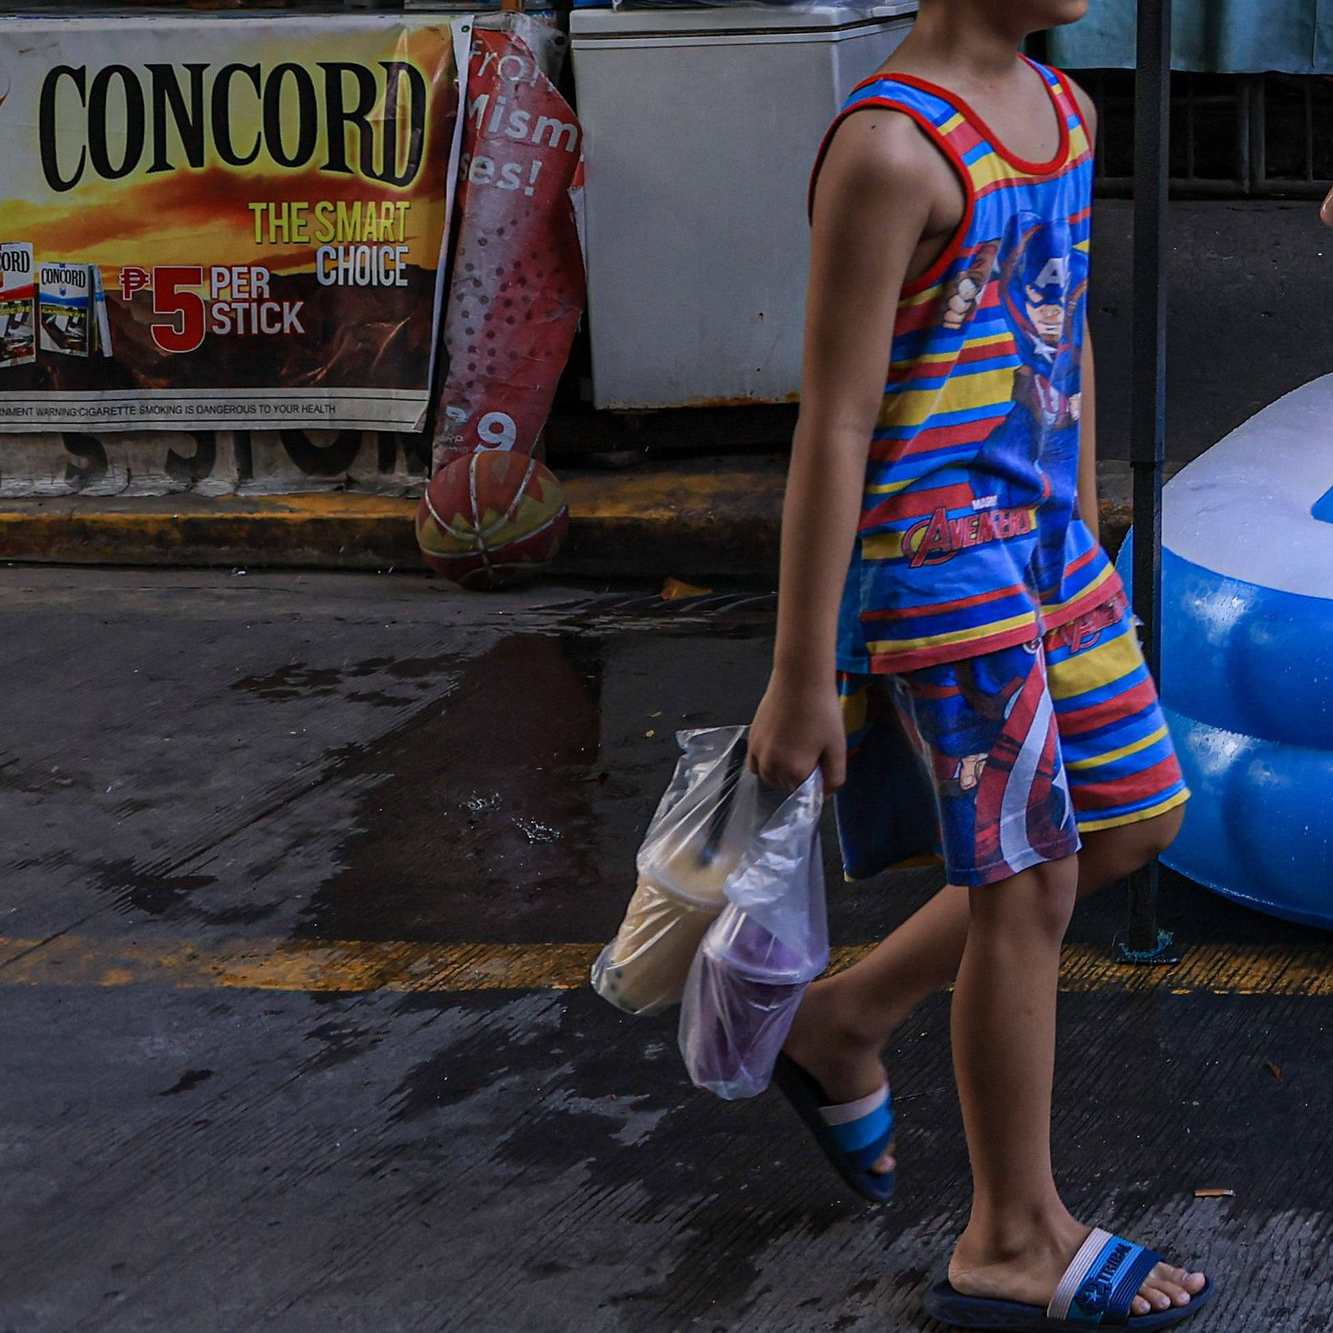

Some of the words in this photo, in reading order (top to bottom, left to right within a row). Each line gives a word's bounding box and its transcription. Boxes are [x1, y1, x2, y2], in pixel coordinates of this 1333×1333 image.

[38, 60, 426, 193] CONCORD
[248, 203, 308, 243] THE
[315, 201, 411, 243] SMART
[0, 250, 30, 273] ORD
[41, 267, 86, 288] CONCORD
[316, 245, 409, 287] CHOICE
[210, 266, 270, 299] PER
[210, 301, 305, 335] STICK
[139, 404, 182, 415] SMOKING
[185, 404, 194, 415] IS
[196, 403, 257, 415] DANGEROUS
[259, 403, 271, 414] TO
[273, 403, 299, 414] YOUR
[301, 403, 336, 414] HEALTH
